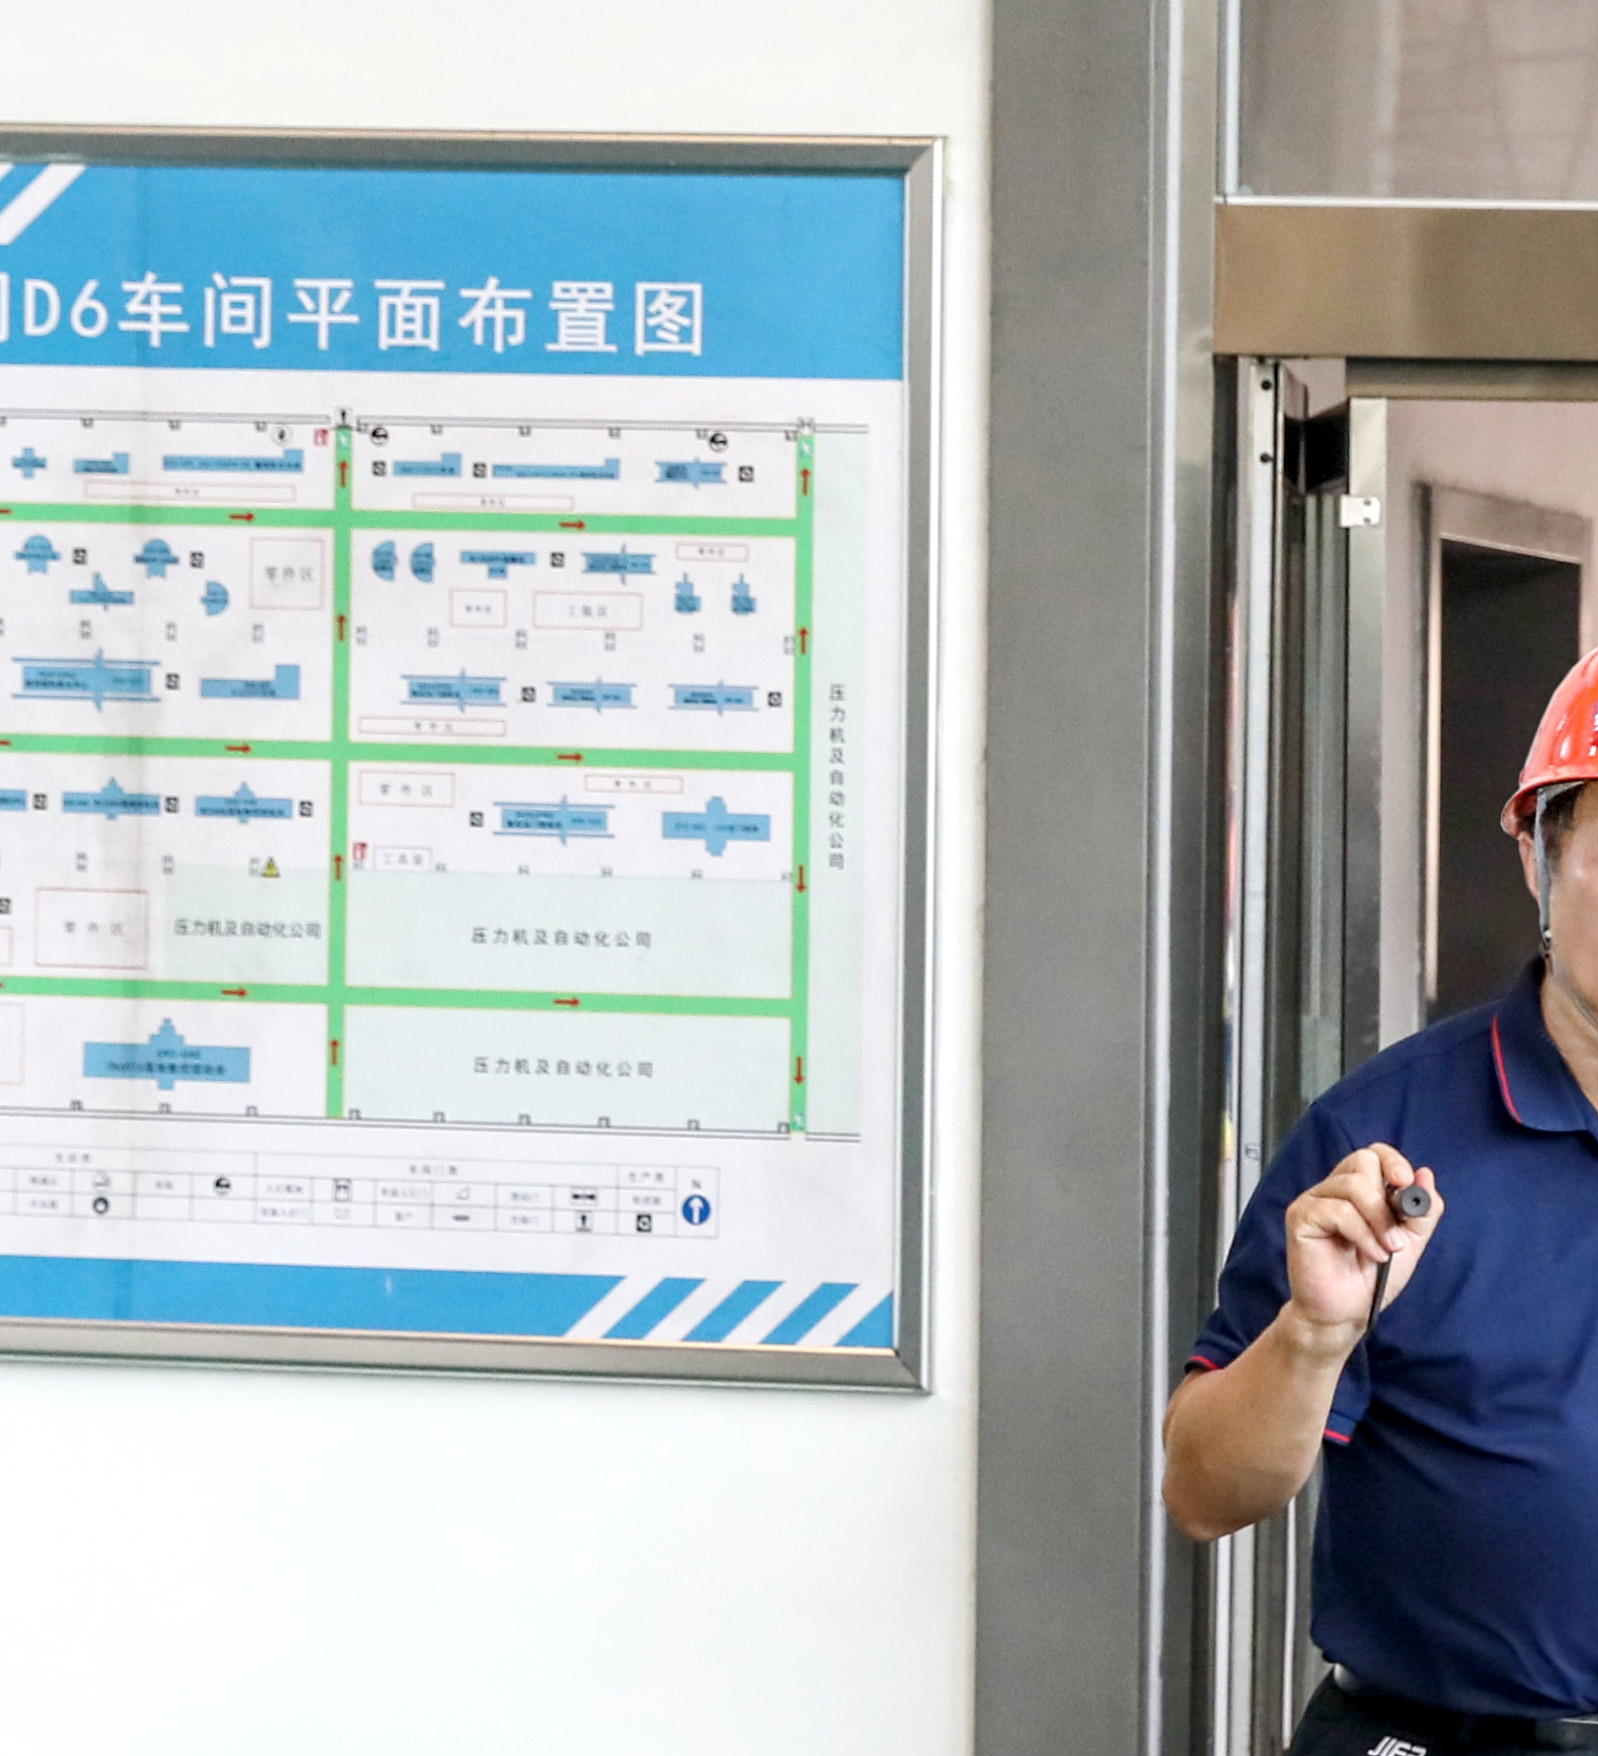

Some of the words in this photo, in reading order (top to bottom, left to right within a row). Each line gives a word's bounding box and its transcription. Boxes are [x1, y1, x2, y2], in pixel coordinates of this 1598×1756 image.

[0, 271, 702, 356] D6车间平面布置图
